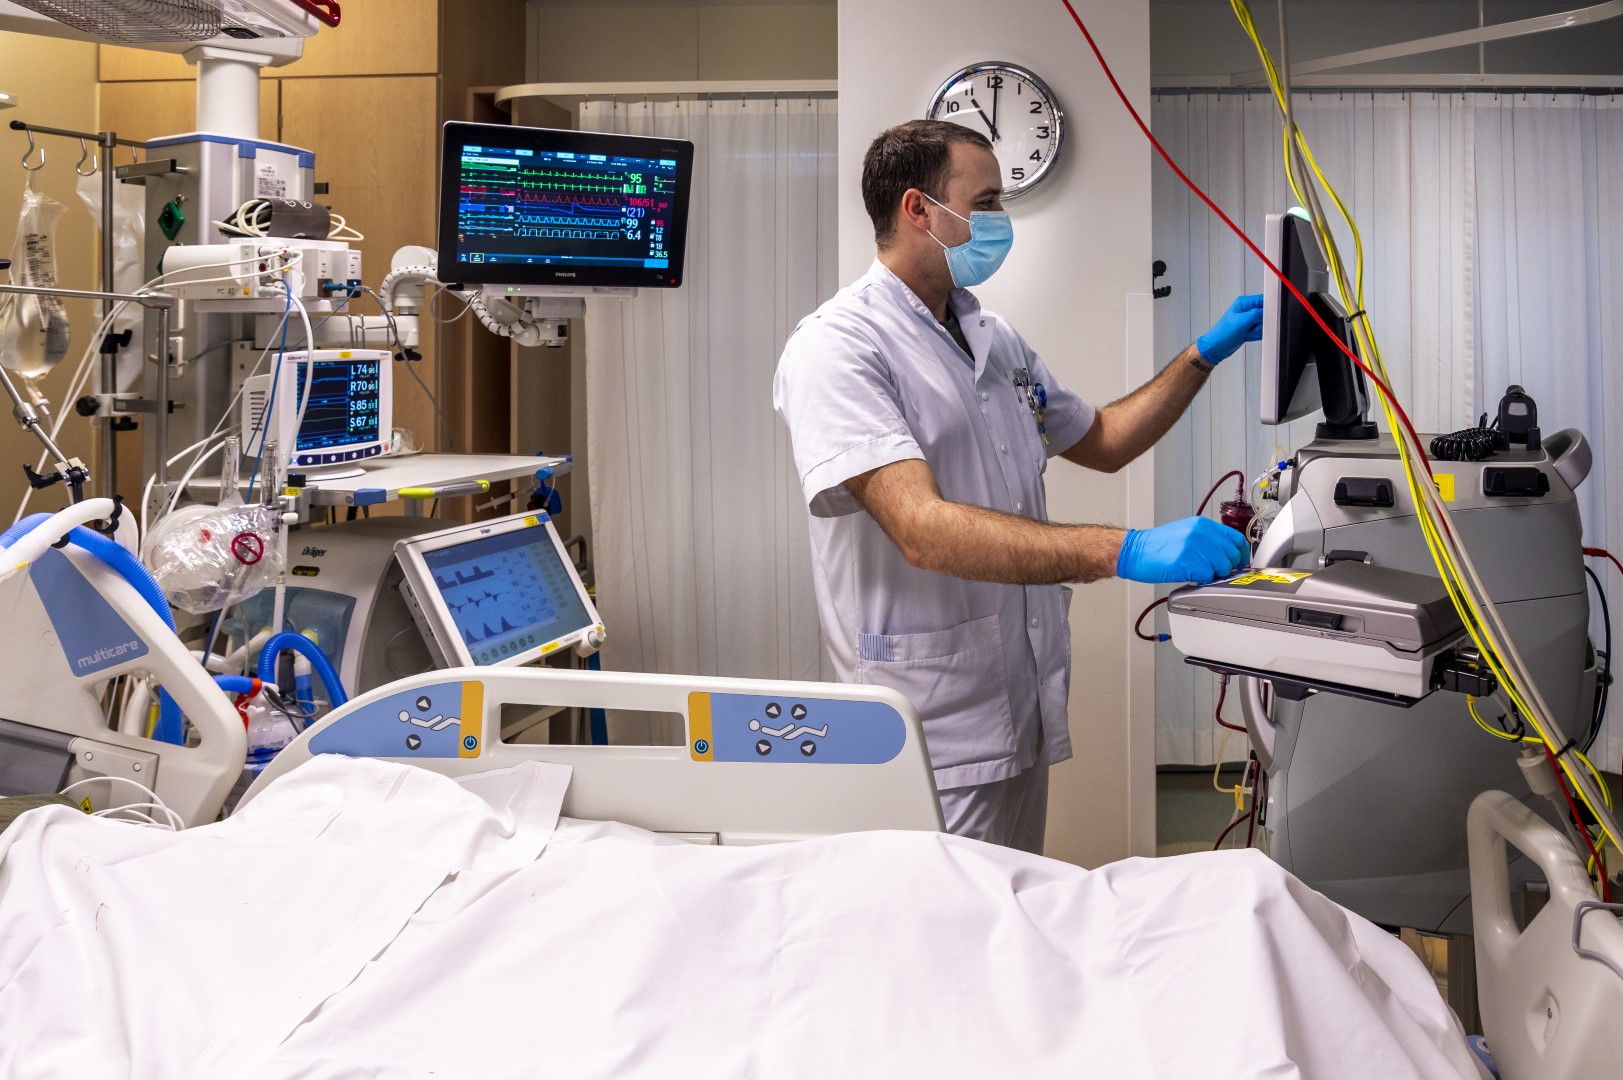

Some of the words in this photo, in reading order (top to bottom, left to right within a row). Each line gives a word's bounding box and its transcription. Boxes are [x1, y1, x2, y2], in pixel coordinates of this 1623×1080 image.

[987, 75, 1003, 89] 12
[964, 83, 974, 96] 11
[1017, 82, 1021, 95] 1
[946, 101, 960, 113] 10
[1029, 101, 1042, 114] 2
[1036, 126, 1050, 139] 3
[1029, 149, 1042, 161] 4
[630, 173, 643, 184] 95
[1011, 167, 1025, 180] 5
[626, 207, 645, 218] (21)
[626, 218, 639, 229] 99
[627, 229, 641, 240] 6.4
[301, 546, 328, 558] Dräger
[77, 640, 140, 668] multicare
